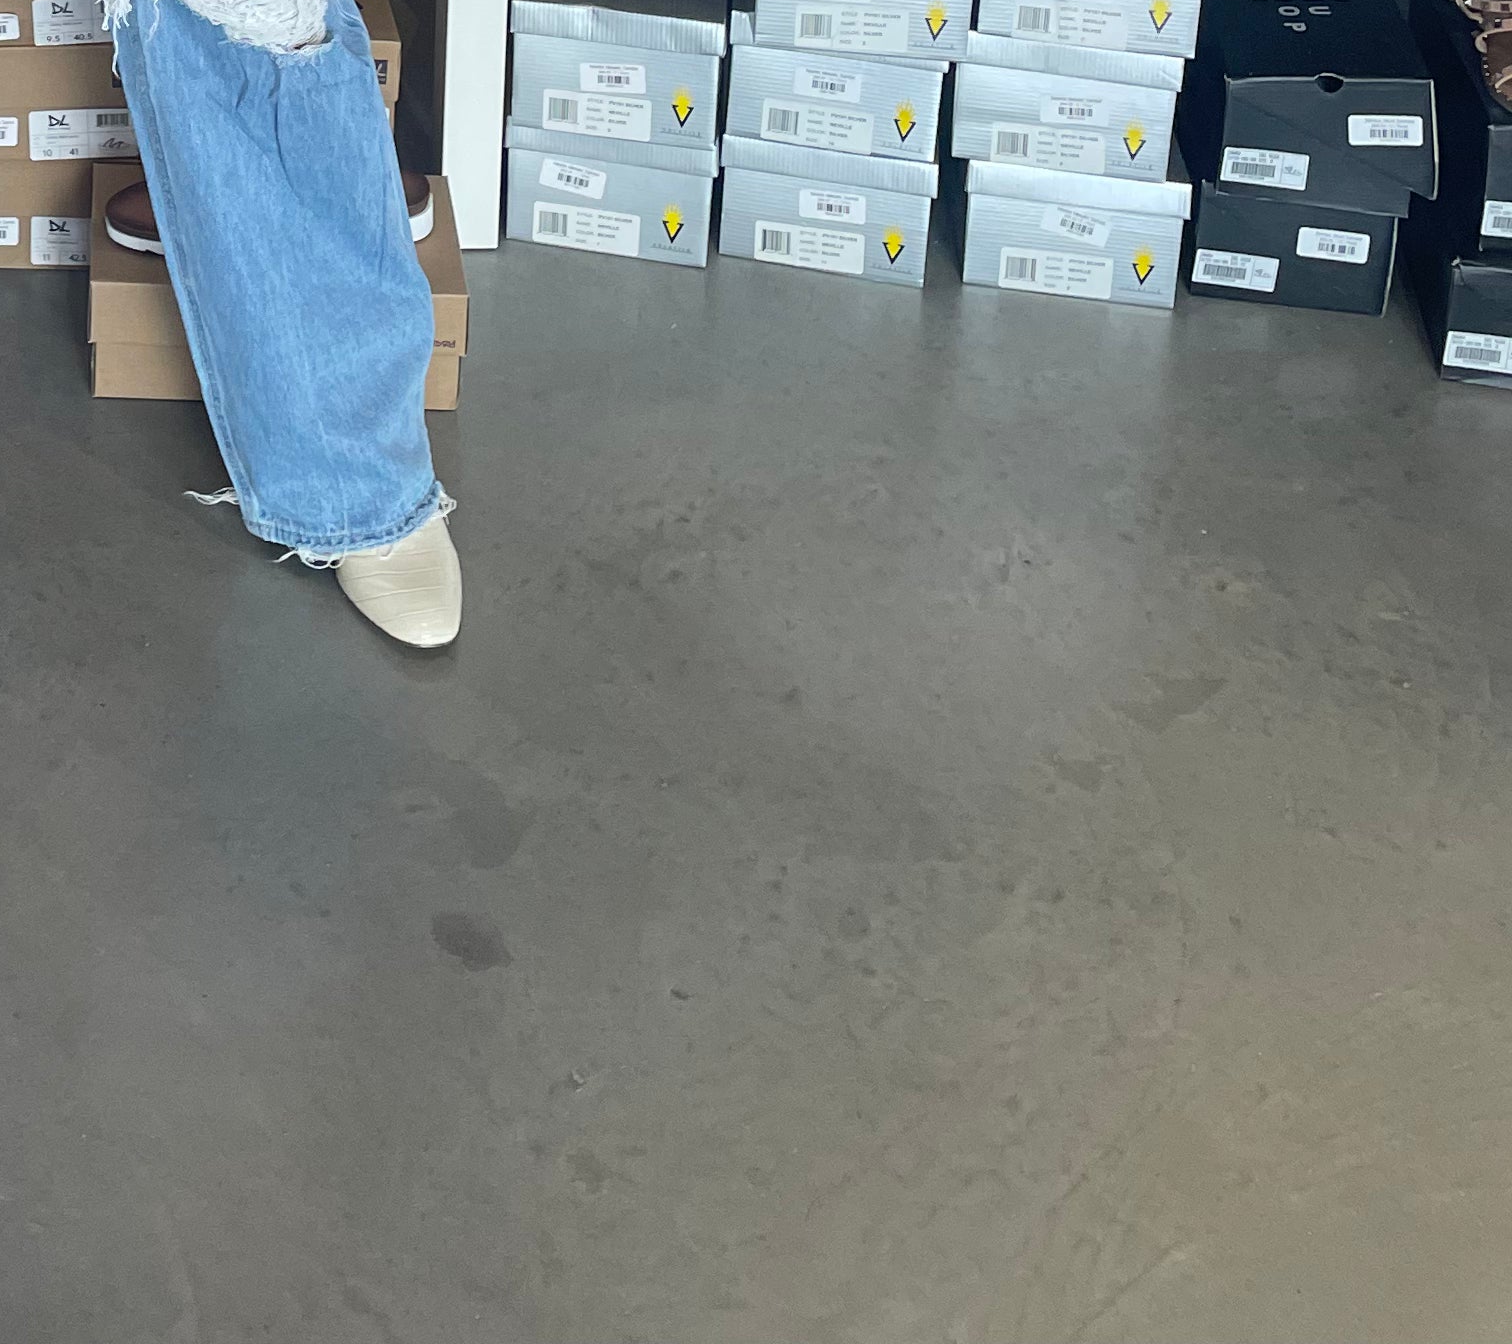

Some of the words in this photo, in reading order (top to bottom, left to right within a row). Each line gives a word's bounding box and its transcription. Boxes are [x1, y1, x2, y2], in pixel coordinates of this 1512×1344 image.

[51, 2, 74, 14] DL
[48, 114, 70, 127] DL
[48, 219, 71, 232] DL
